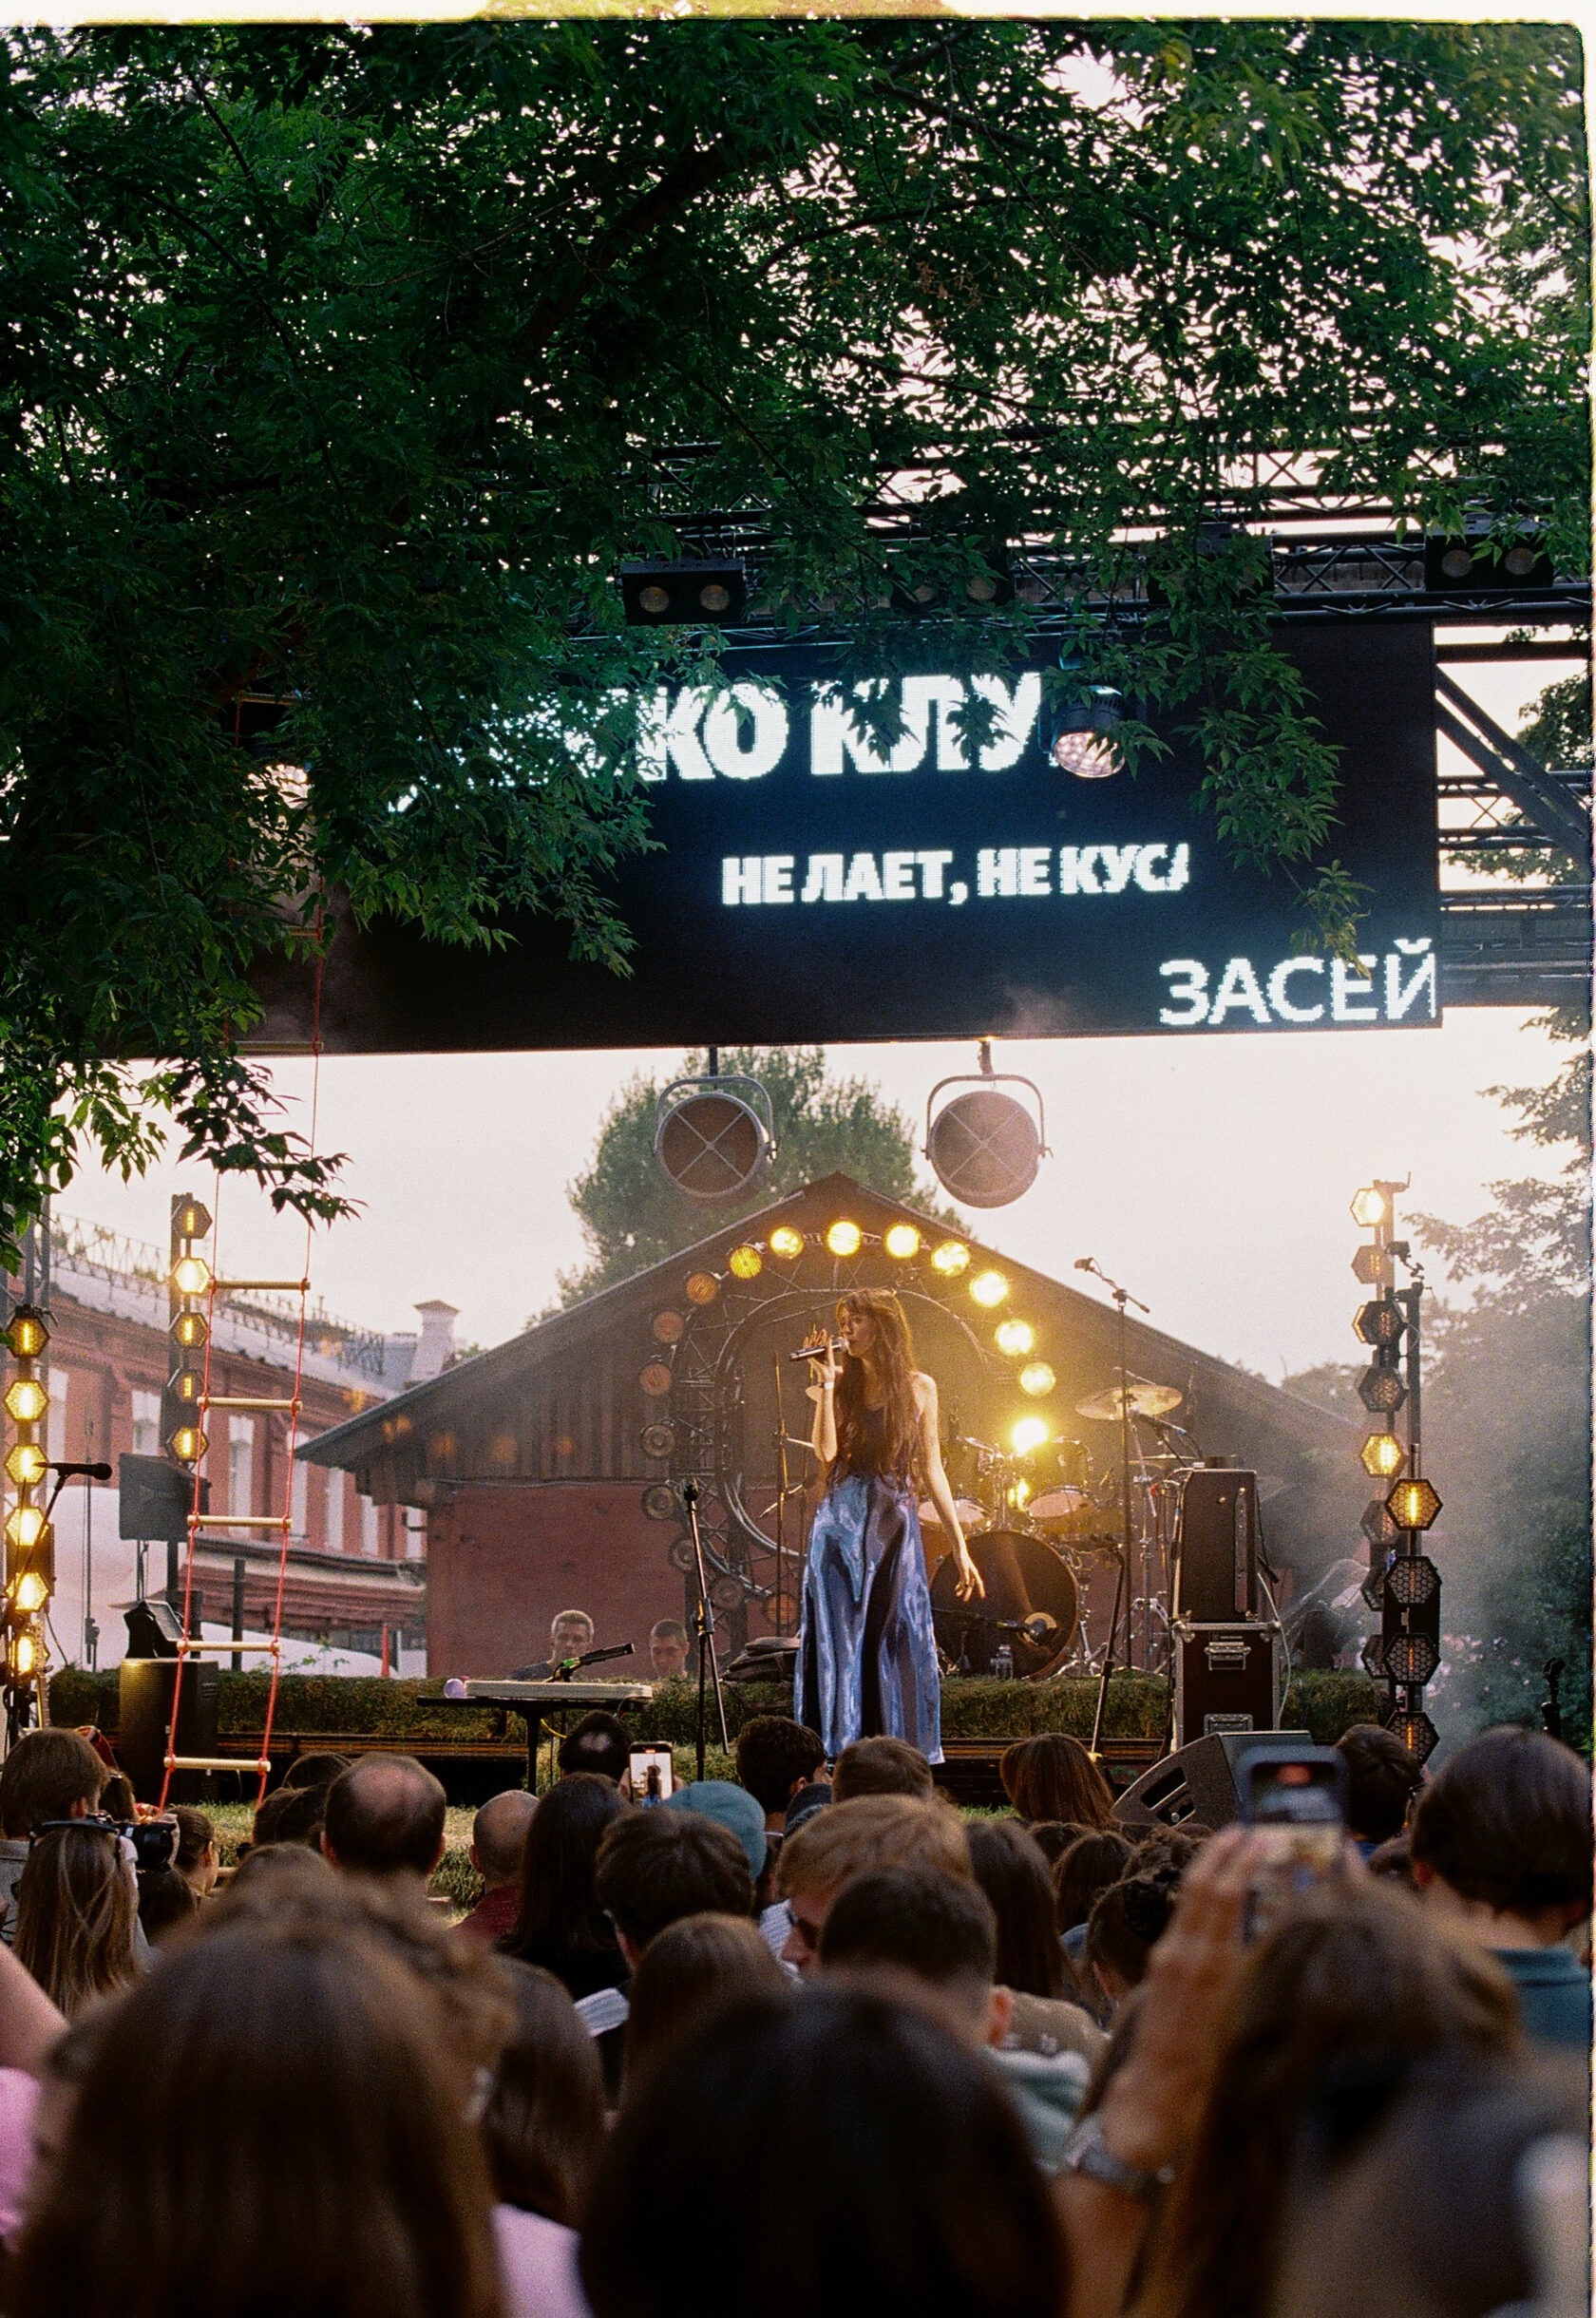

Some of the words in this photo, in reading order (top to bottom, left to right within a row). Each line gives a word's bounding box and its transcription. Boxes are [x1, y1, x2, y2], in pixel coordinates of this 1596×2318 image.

[810, 672, 1059, 776] КЛУ
[722, 855, 795, 905] НЕ
[801, 849, 968, 905] ЛАЕТ,
[977, 846, 1053, 897] НЕ
[1159, 937, 1437, 1027] ЗАСЕЙ
